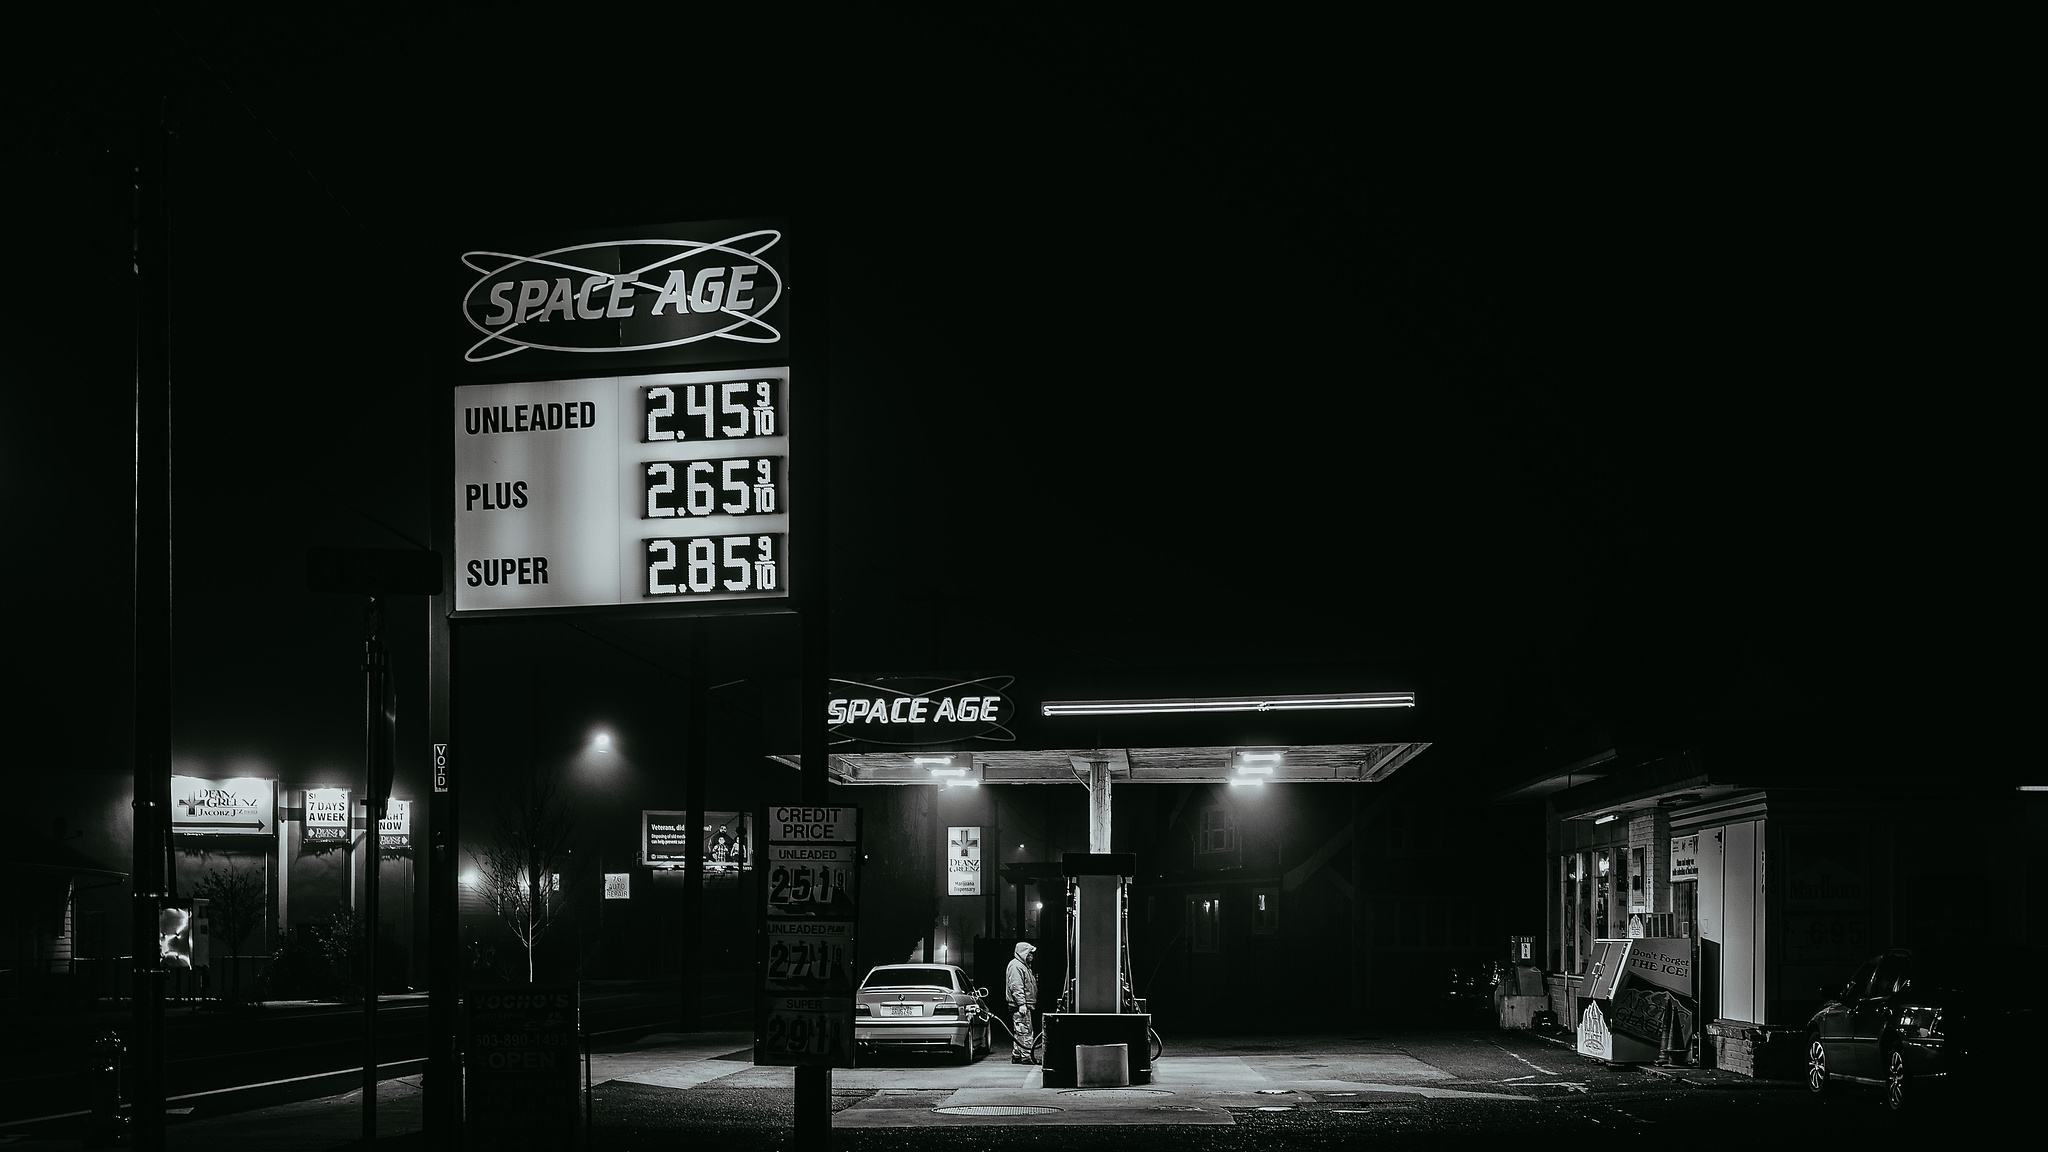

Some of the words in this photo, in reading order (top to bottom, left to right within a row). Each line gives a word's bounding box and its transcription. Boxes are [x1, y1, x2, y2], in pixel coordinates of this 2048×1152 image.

[485, 273, 639, 326] SPACE
[651, 265, 758, 316] AGE
[465, 402, 596, 434] UNLEADED
[648, 383, 749, 440] 2.45
[466, 481, 528, 511] PLUS
[648, 460, 750, 517] 2.65
[466, 557, 548, 587] SUPER
[649, 537, 751, 594] 2.85
[828, 698, 930, 723] SPACE
[933, 696, 1001, 722] AGE
[436, 746, 446, 786] VOID
[310, 802, 315, 811] 7
[318, 802, 345, 811] DAYS
[776, 808, 841, 822] CREDIT
[309, 813, 316, 821] A
[318, 813, 345, 821] WEEK
[380, 822, 402, 830] NOW
[783, 824, 834, 839] PRICE
[778, 850, 837, 859] UNLEADED
[1789, 874, 1861, 899] Marlboro
[768, 924, 826, 934] UNLEADED
[1632, 949, 1658, 960] Don't
[1660, 953, 1690, 967] Forget
[1630, 958, 1658, 971] THE
[1661, 965, 1688, 978] ICE!
[786, 1000, 822, 1009] SUPER
[489, 1052, 555, 1068] OPEN
